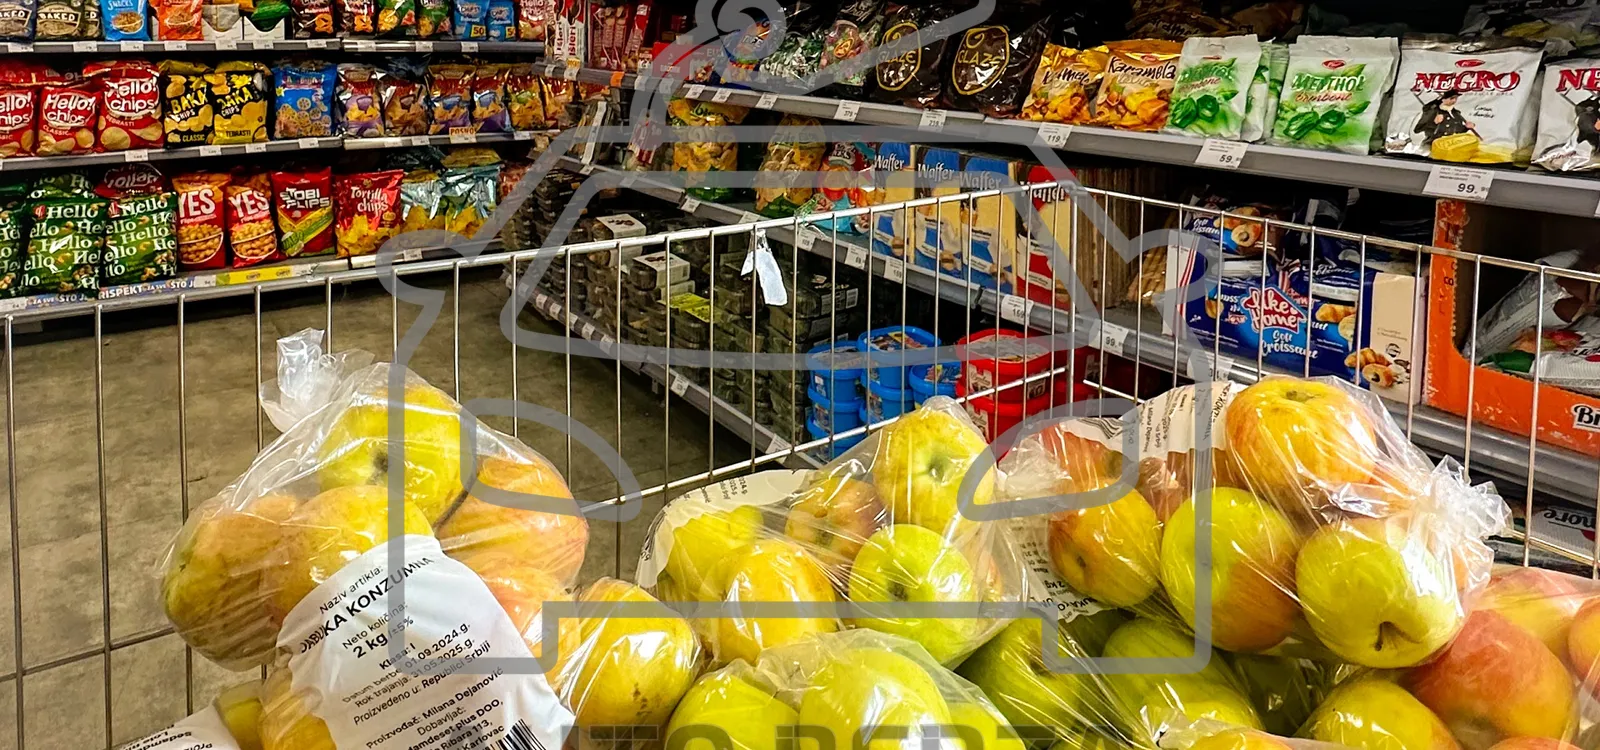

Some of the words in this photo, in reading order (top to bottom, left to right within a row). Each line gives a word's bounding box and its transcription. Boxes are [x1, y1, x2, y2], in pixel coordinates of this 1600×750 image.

[38, 12, 76, 22] BAKED
[473, 25, 485, 35] 50
[568, 26, 576, 56] Išleri
[1291, 73, 1366, 92] MENTHOL
[1410, 70, 1521, 93] NEGRO
[44, 93, 96, 111] Hello!
[110, 97, 156, 113] chips
[171, 87, 209, 114] BAKA
[47, 111, 86, 125] chips
[873, 153, 905, 171] Waffer
[917, 162, 955, 182] Waffer
[958, 171, 1002, 190] Waffer
[178, 187, 216, 218] YES
[229, 189, 270, 219] YES
[279, 187, 320, 199] STOBI
[285, 198, 330, 209] FLIPS
[350, 186, 388, 201] Tortilla
[46, 203, 99, 220] Hello
[357, 197, 389, 213] chips
[120, 226, 169, 244] Hello
[99, 285, 144, 300] RISPEKT
[320, 591, 348, 614] Naziv
[348, 565, 384, 593] artikla:
[345, 556, 435, 617] KONZUMNA
[342, 629, 369, 649] Neto
[367, 601, 408, 632] količina:
[353, 645, 367, 659] 2
[365, 633, 388, 651] kg
[379, 647, 410, 670] Klasa:
[412, 684, 422, 696] u:
[421, 659, 465, 689] Republici
[464, 640, 491, 664] Srbiji
[354, 695, 375, 708] Rok
[374, 675, 412, 699] trajanja:
[366, 716, 422, 750] Proizvođač:
[422, 698, 456, 720] Milana
[455, 667, 504, 702] Dejanović
[455, 714, 477, 731] plus
[475, 698, 504, 717] DOO,
[416, 706, 467, 736] Dobavljač:
[440, 730, 473, 750] Ribara
[471, 720, 493, 733] 113,
[462, 725, 505, 750] Karlovac
